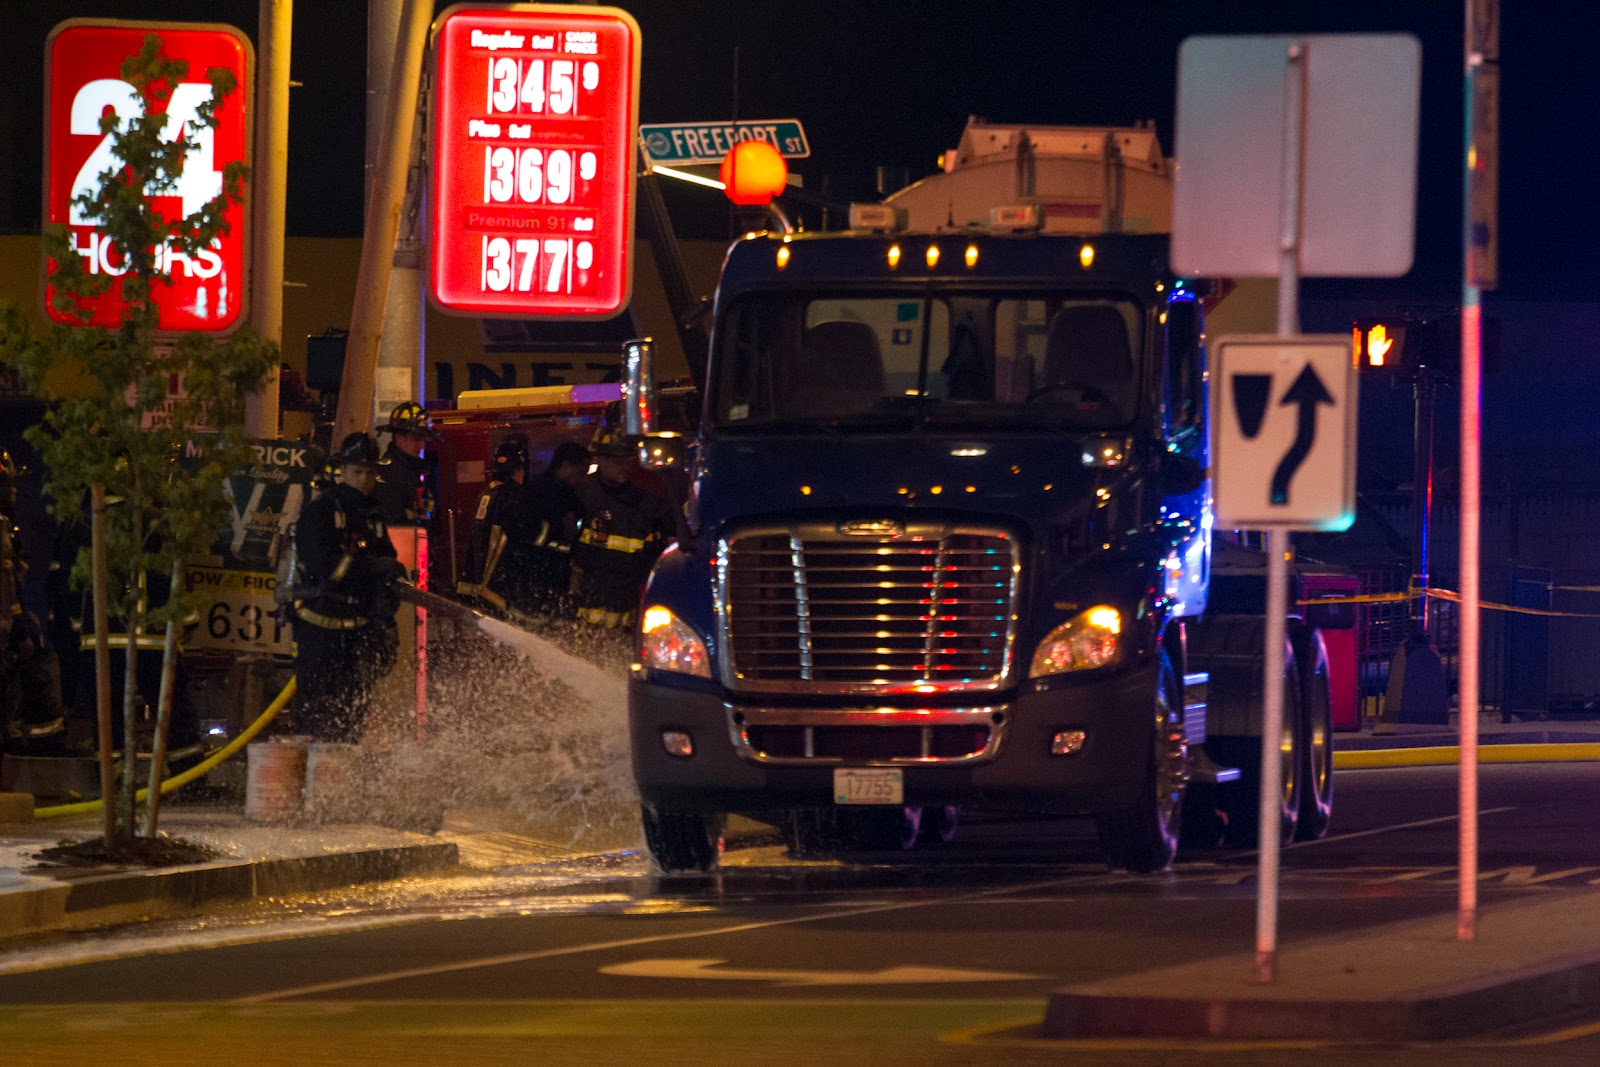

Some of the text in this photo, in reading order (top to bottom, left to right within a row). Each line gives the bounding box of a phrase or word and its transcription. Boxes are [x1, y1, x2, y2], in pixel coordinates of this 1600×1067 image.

[471, 30, 525, 50] Regular
[469, 120, 501, 138] Plus
[671, 126, 801, 157] FREEPORT ST
[69, 79, 224, 225] 24
[469, 213, 541, 229] Premium
[547, 216, 566, 230] 91
[185, 440, 306, 468] MRICK
[185, 571, 224, 585] OW
